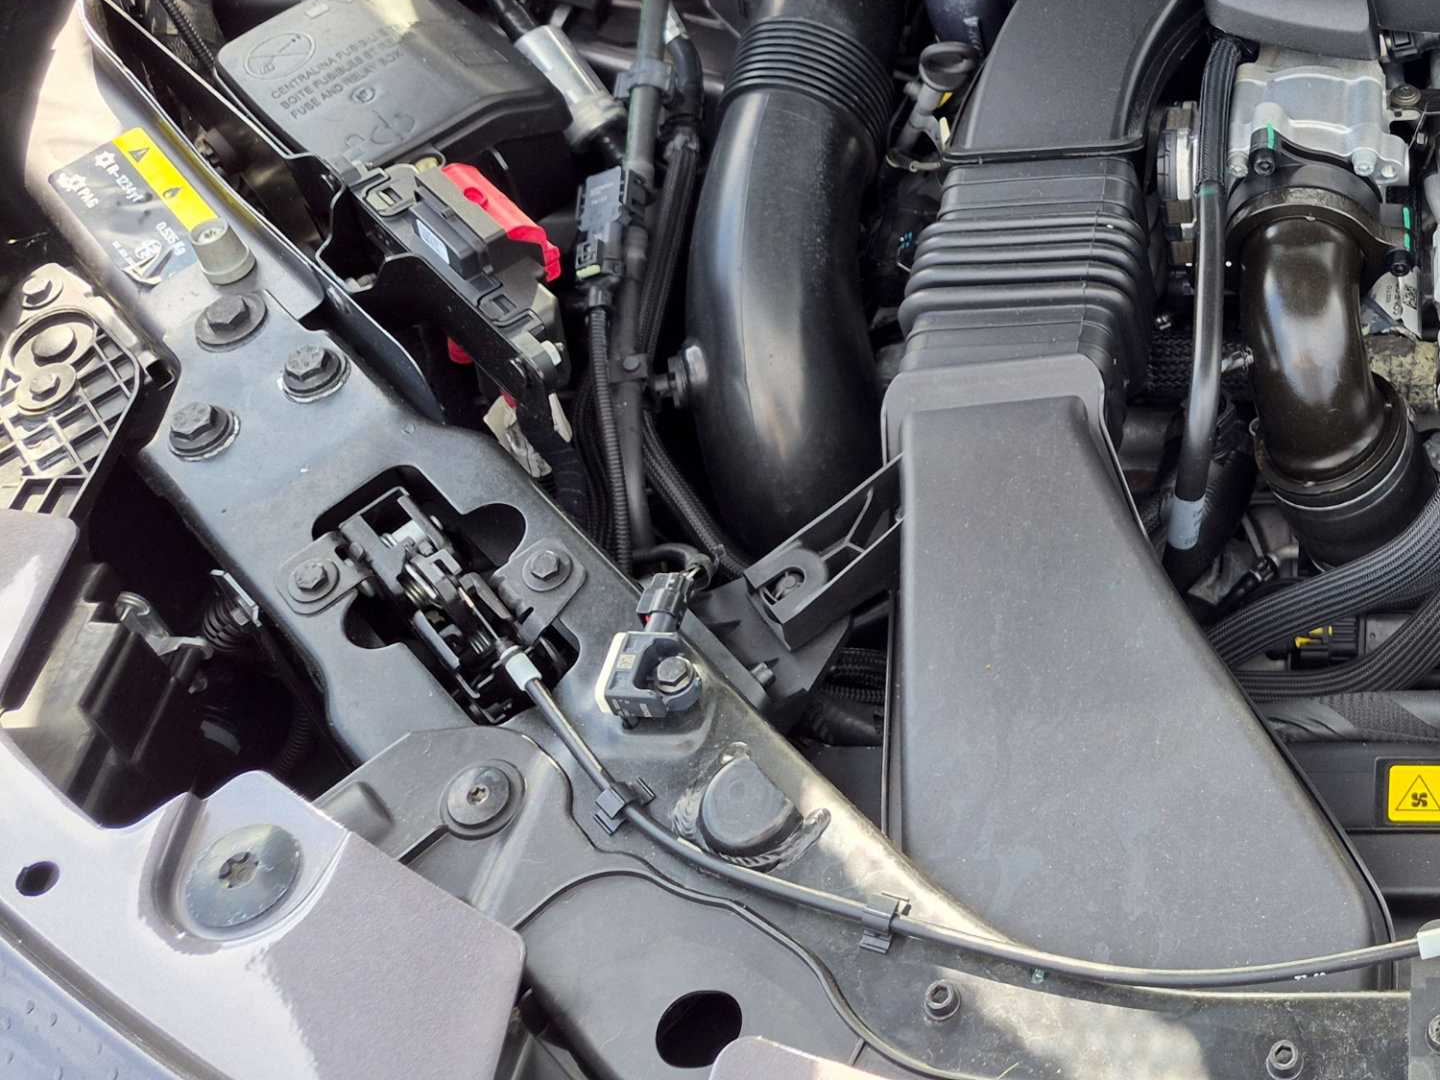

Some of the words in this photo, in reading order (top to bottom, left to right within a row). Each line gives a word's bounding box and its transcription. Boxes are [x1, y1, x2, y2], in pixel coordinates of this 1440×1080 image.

[290, 97, 321, 119] FUSE
[321, 82, 344, 101] AND
[77, 185, 100, 209] PAG
